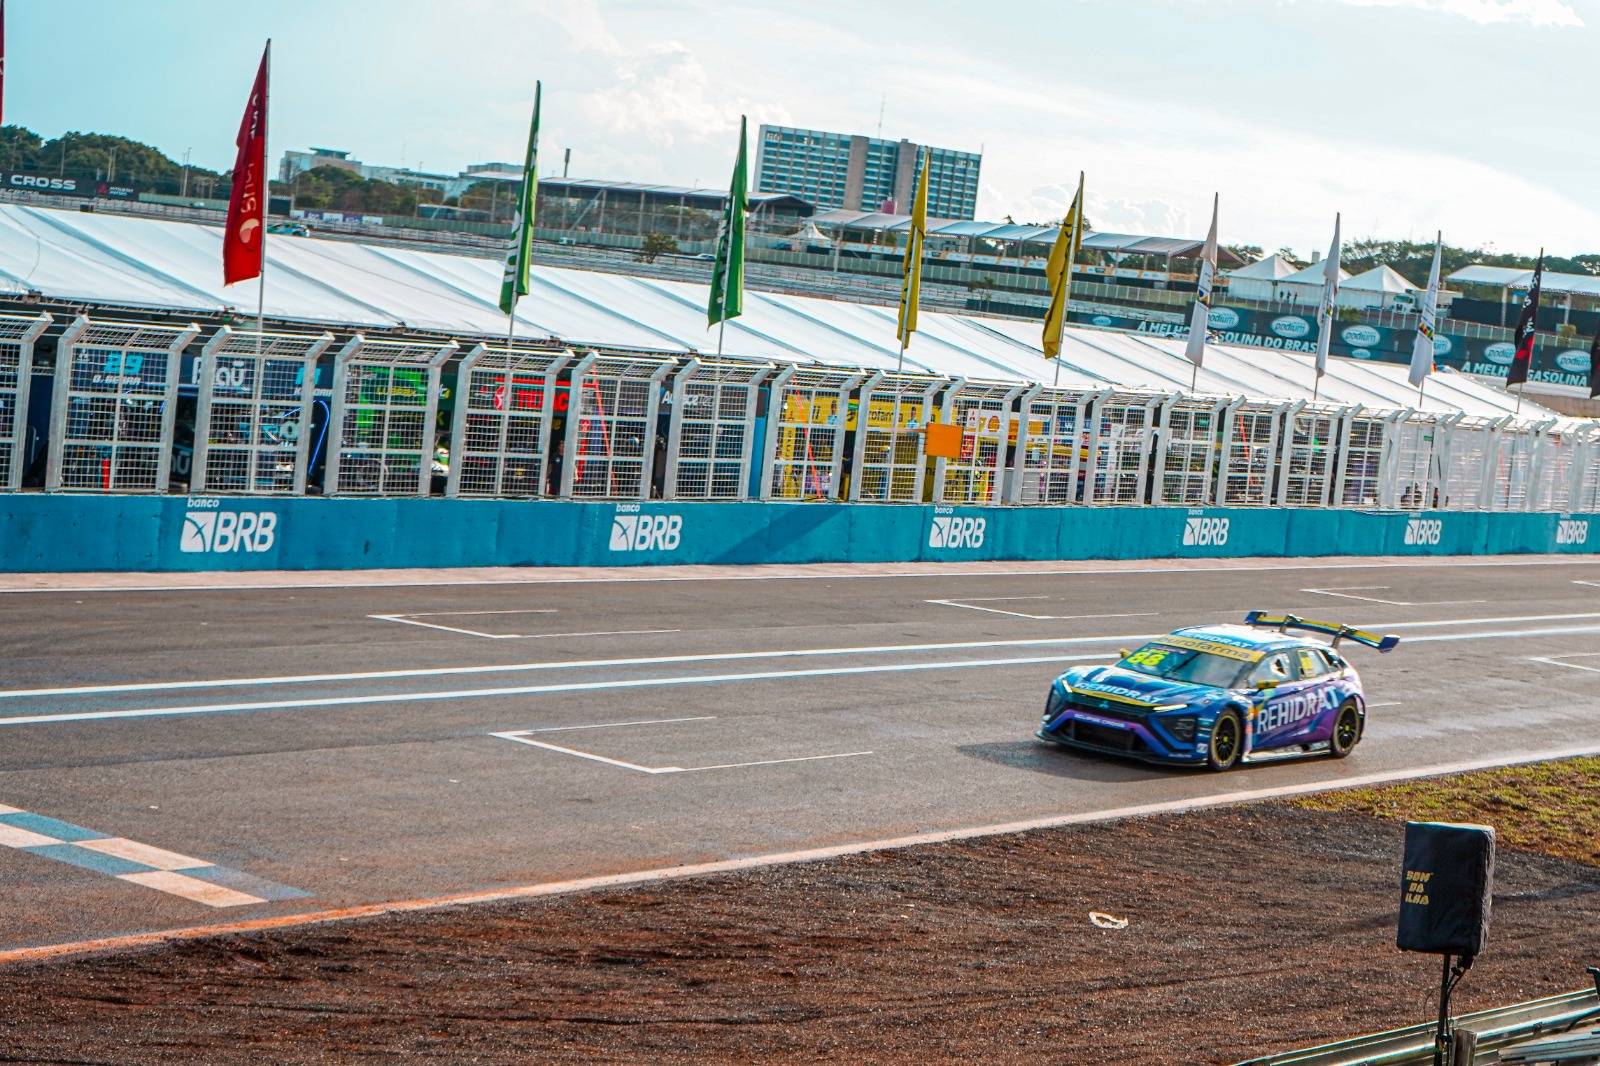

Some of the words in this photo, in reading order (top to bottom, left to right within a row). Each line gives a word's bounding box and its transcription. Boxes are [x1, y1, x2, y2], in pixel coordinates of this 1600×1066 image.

[10, 174, 77, 191] CROSS
[1137, 321, 1147, 332] A
[1149, 322, 1191, 336] MELHO
[1217, 331, 1261, 346] SOLINA
[1263, 336, 1283, 349] DO
[1284, 338, 1318, 353] BRAS
[1275, 321, 1306, 333] podium
[1345, 331, 1376, 342] podium
[1488, 348, 1515, 359] podiu
[1461, 361, 1471, 373] A
[1473, 362, 1510, 378] MELH
[187, 496, 220, 508] banco
[616, 503, 640, 513] banco
[213, 511, 277, 552] BRB
[634, 514, 683, 551] BRB
[947, 517, 987, 549] BRB
[1198, 517, 1230, 546] BRB
[1416, 519, 1442, 545] BRB
[1566, 520, 1588, 544] BRB
[1126, 650, 1166, 667] 88
[1158, 636, 1251, 659] eurofarma
[1075, 682, 1164, 704] REHIDRAT
[1256, 686, 1340, 735] REHIDRAT
